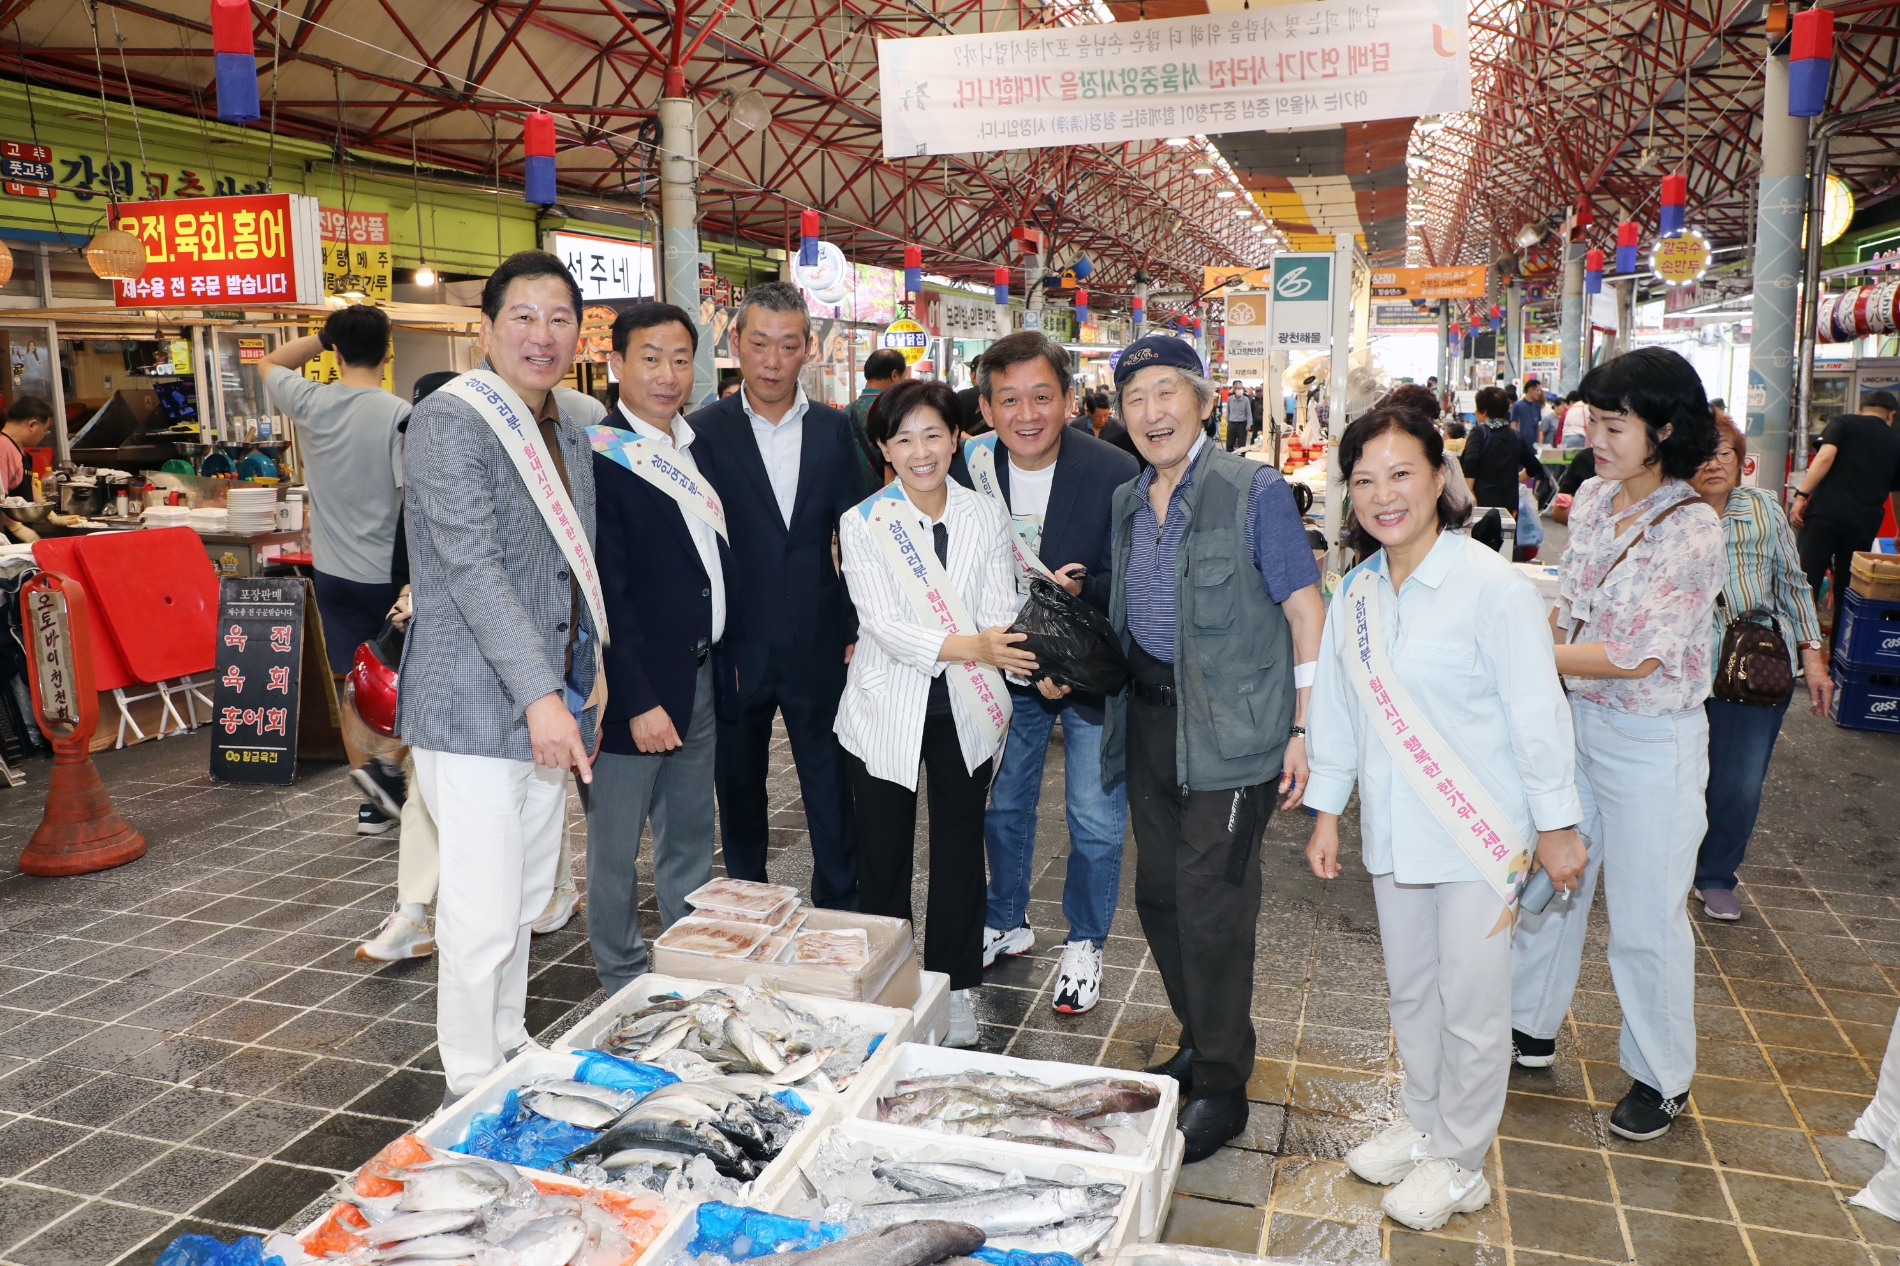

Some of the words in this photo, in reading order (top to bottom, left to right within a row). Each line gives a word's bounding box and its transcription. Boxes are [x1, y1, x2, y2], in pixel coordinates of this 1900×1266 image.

[1663, 241, 1701, 256] 칼국수
[1661, 259, 1700, 274] 손만두
[122, 277, 165, 298] 제수용
[170, 277, 186, 297] 전
[191, 275, 221, 297] 주문
[226, 273, 287, 294] 받습니다
[886, 333, 925, 347] 충남닭집
[1278, 332, 1321, 344] 광천해물
[651, 453, 705, 499] 상인여러분!
[463, 376, 526, 441] 상인여러분!
[522, 442, 555, 500] 힘내시고
[551, 500, 577, 541] 행복한
[573, 542, 594, 581] 한가위
[590, 586, 605, 627] 되세요
[888, 519, 930, 588] 상인여러분!
[925, 588, 960, 635] 힘내시고
[240, 588, 282, 602] 포장판매
[247, 608, 255, 617] 전
[37, 594, 60, 667] 오토바이
[970, 672, 995, 703] 한가위
[987, 702, 1006, 731] 되세요
[219, 705, 288, 737] 홍어회
[1354, 595, 1373, 674] 상인여러분!
[1368, 675, 1410, 736] 힘내시고
[1402, 734, 1443, 779] 행복한
[1436, 777, 1478, 821] 한가위
[1470, 818, 1511, 862] 되세요
[242, 751, 278, 763] 황금육전
